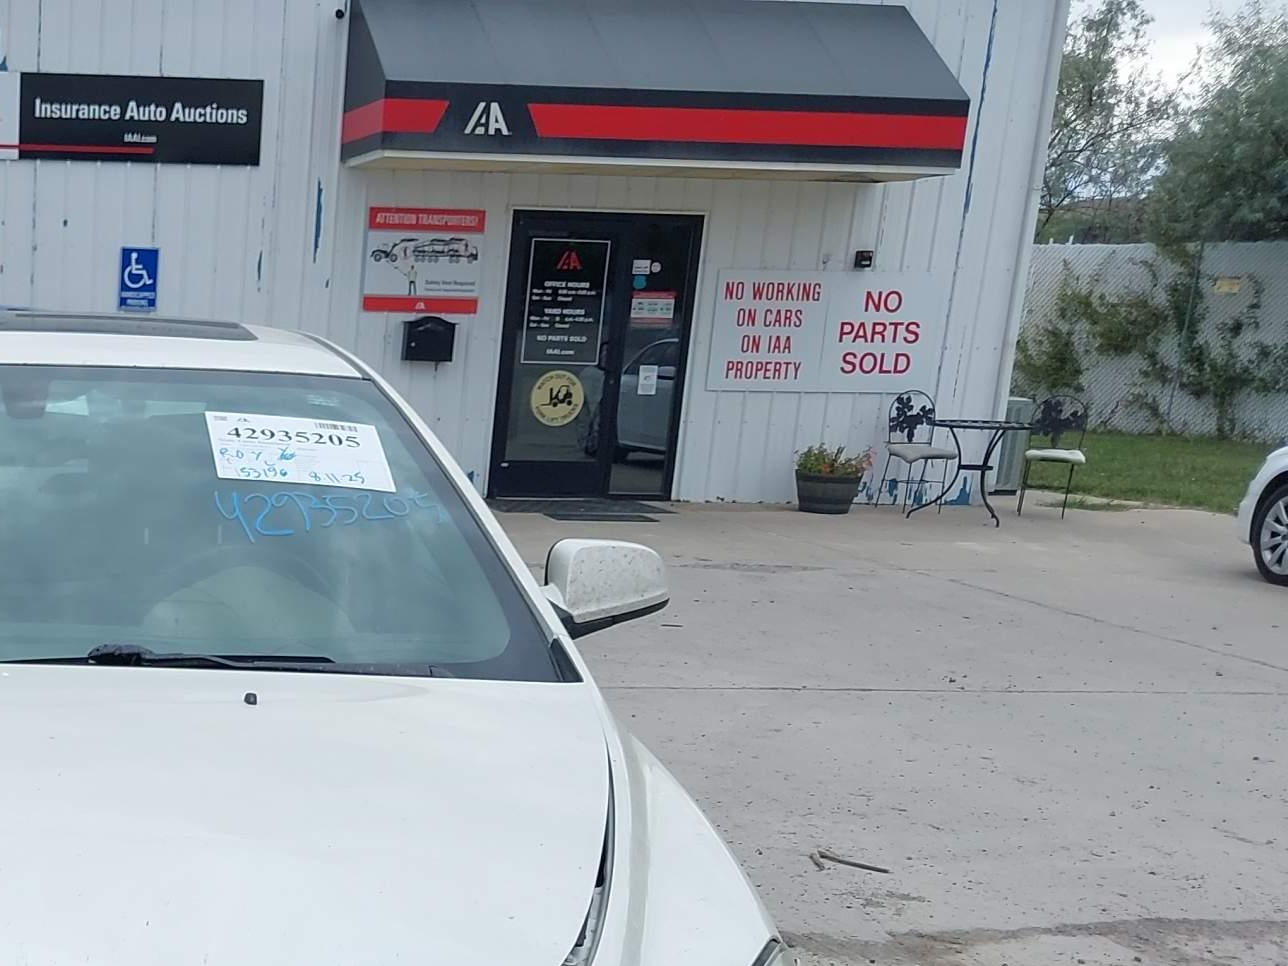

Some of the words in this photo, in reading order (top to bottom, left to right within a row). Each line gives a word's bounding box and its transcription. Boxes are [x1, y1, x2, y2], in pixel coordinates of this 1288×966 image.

[34, 98, 121, 121] Insurance
[124, 100, 167, 122] Auto
[170, 101, 248, 125] Auctions
[724, 281, 745, 301] NO
[752, 282, 822, 302] WORKING
[864, 291, 903, 313] NO
[736, 308, 757, 328] ON
[764, 309, 803, 329] CARS
[838, 322, 921, 345] PARTS
[741, 335, 761, 354] ON
[767, 335, 792, 354] IAA
[725, 361, 802, 380] PROPERTY
[840, 352, 911, 375] SOLD
[227, 427, 361, 448] 42935205
